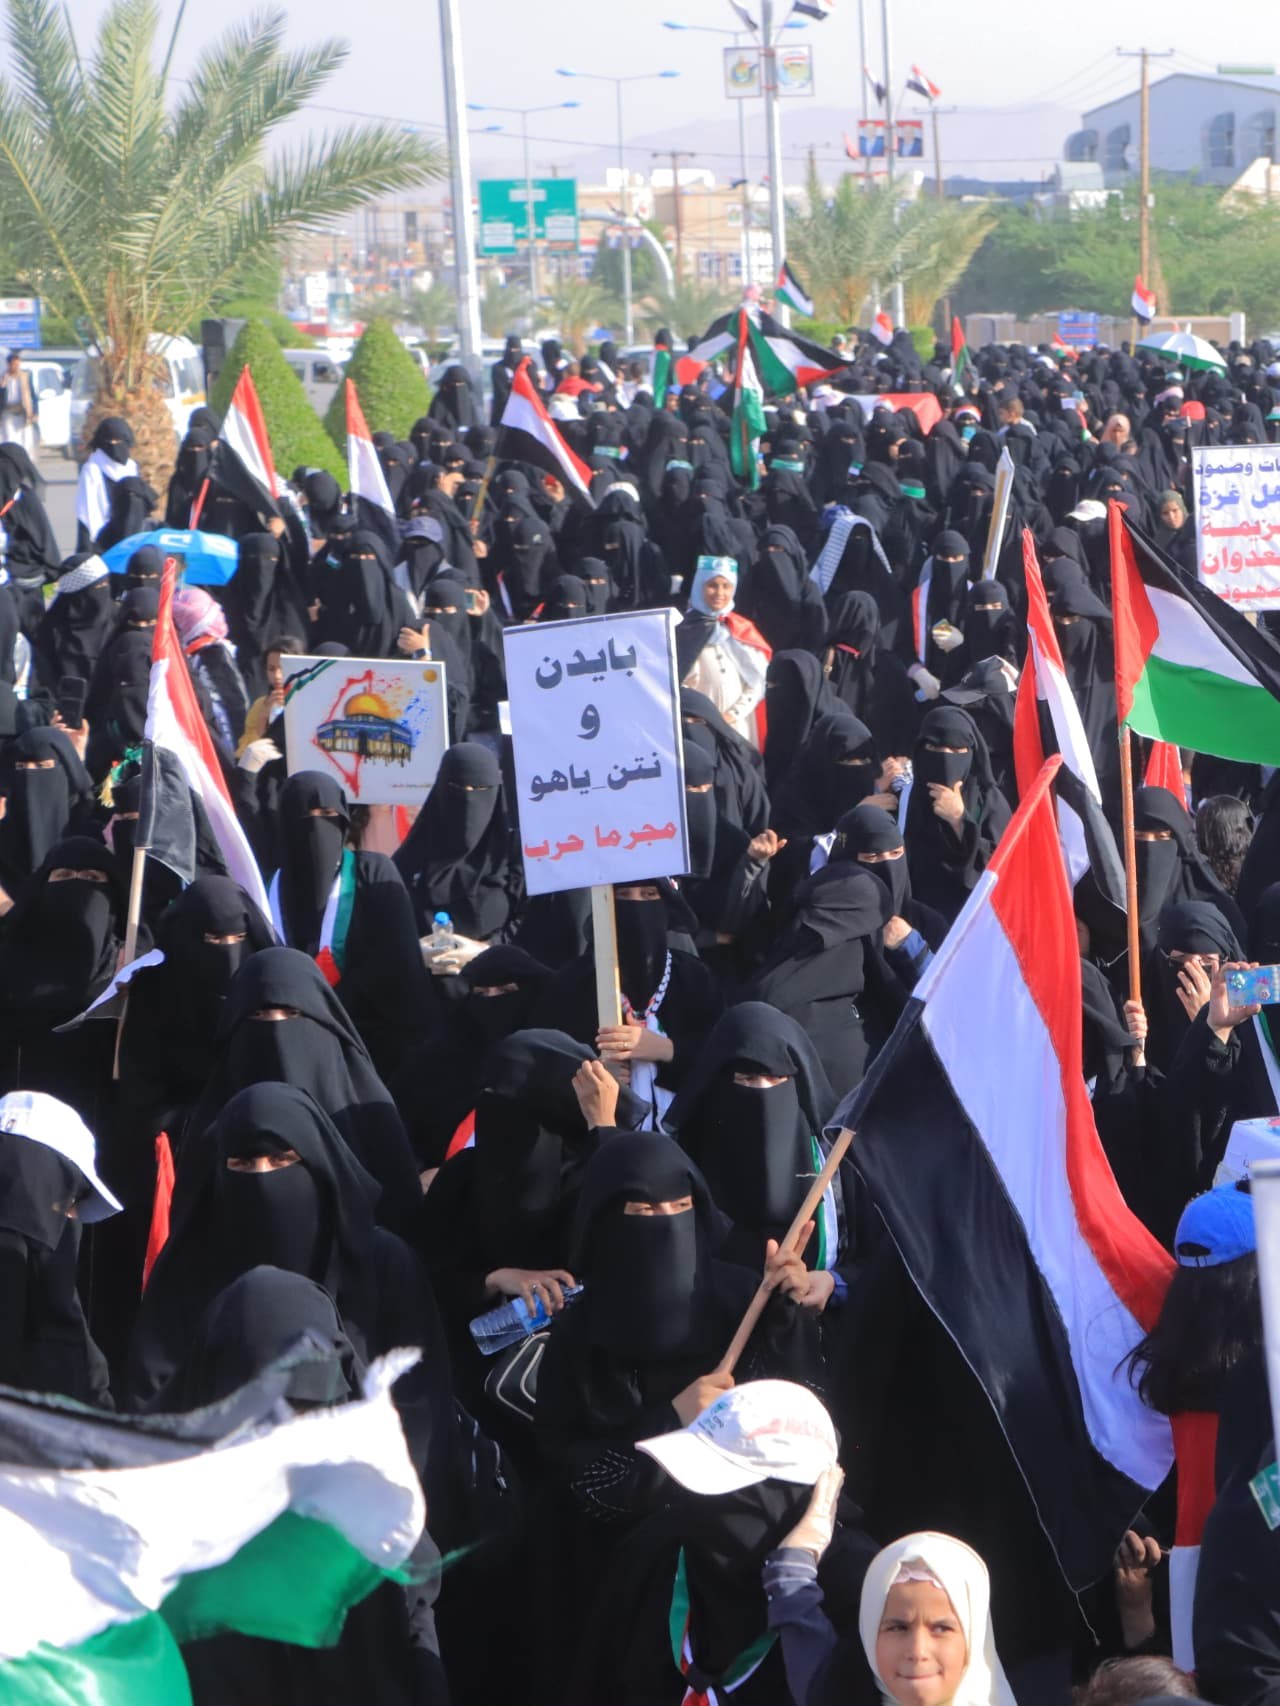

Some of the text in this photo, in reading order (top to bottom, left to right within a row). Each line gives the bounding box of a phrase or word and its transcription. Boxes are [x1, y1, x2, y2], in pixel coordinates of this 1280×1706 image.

[1195, 461, 1253, 478] وصمود
[1199, 485, 1242, 511] غزة
[535, 637, 638, 689] بايدن
[577, 704, 600, 740] و
[523, 821, 678, 861] مجرما حرب
